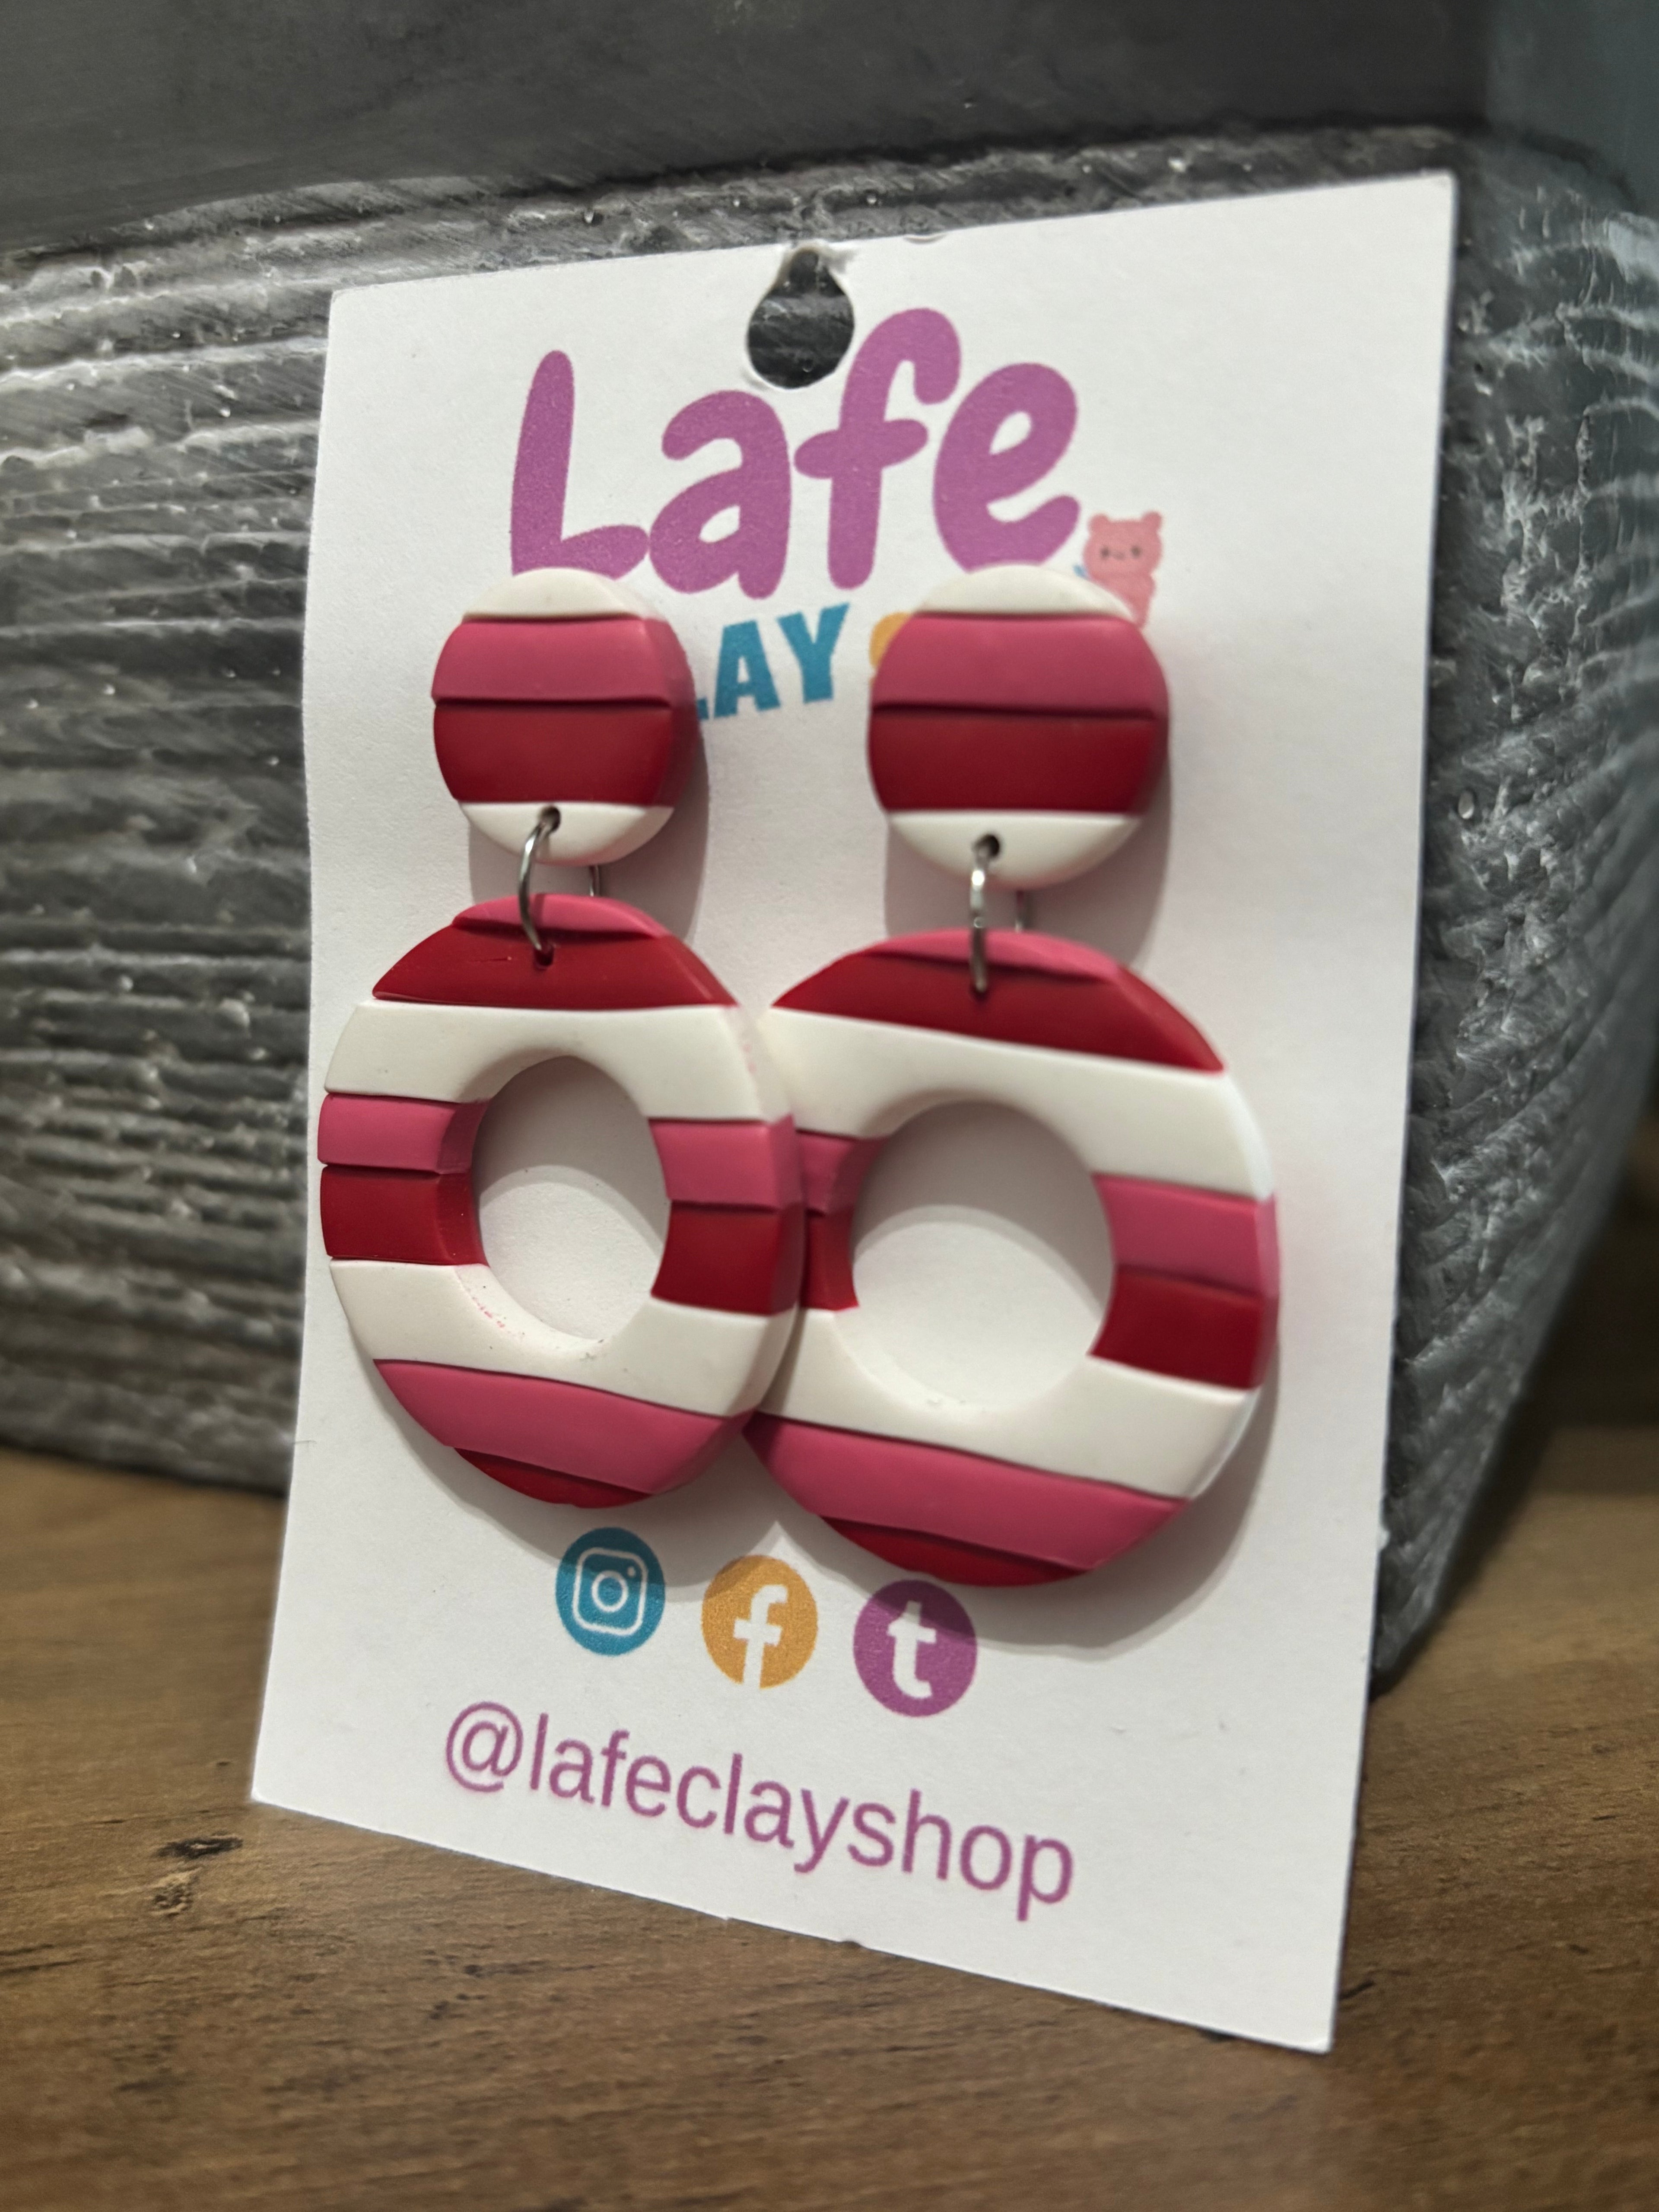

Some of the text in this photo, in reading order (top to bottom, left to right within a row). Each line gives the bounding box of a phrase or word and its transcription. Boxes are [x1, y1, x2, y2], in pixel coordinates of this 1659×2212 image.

[511, 308, 1080, 599] Lafe
[696, 602, 850, 721] AY
[445, 1702, 1074, 1921] @lafeclayshop
